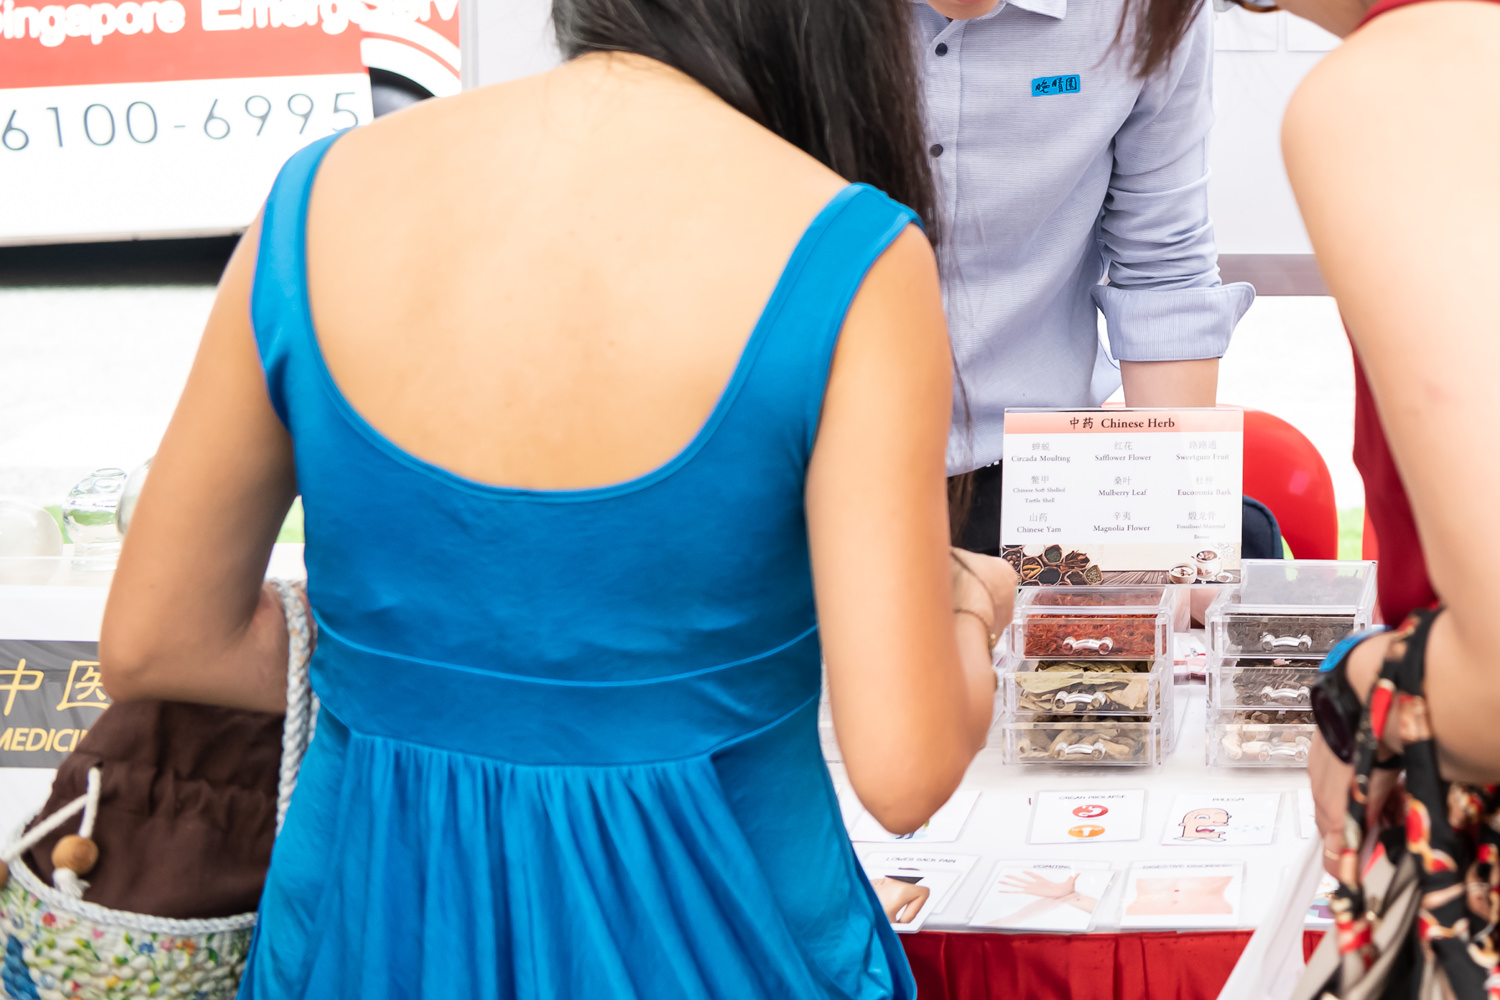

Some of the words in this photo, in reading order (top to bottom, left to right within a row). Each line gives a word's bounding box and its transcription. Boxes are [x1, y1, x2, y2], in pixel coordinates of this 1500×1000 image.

[0, 0, 185, 47] ingapore
[2, 92, 358, 150] 6100-6995
[1070, 417, 1093, 429] 中药
[1101, 418, 1144, 428] Chinese
[1148, 418, 1175, 428] Herb
[1099, 489, 1129, 497] Mulberry
[0, 658, 112, 716] 中医
